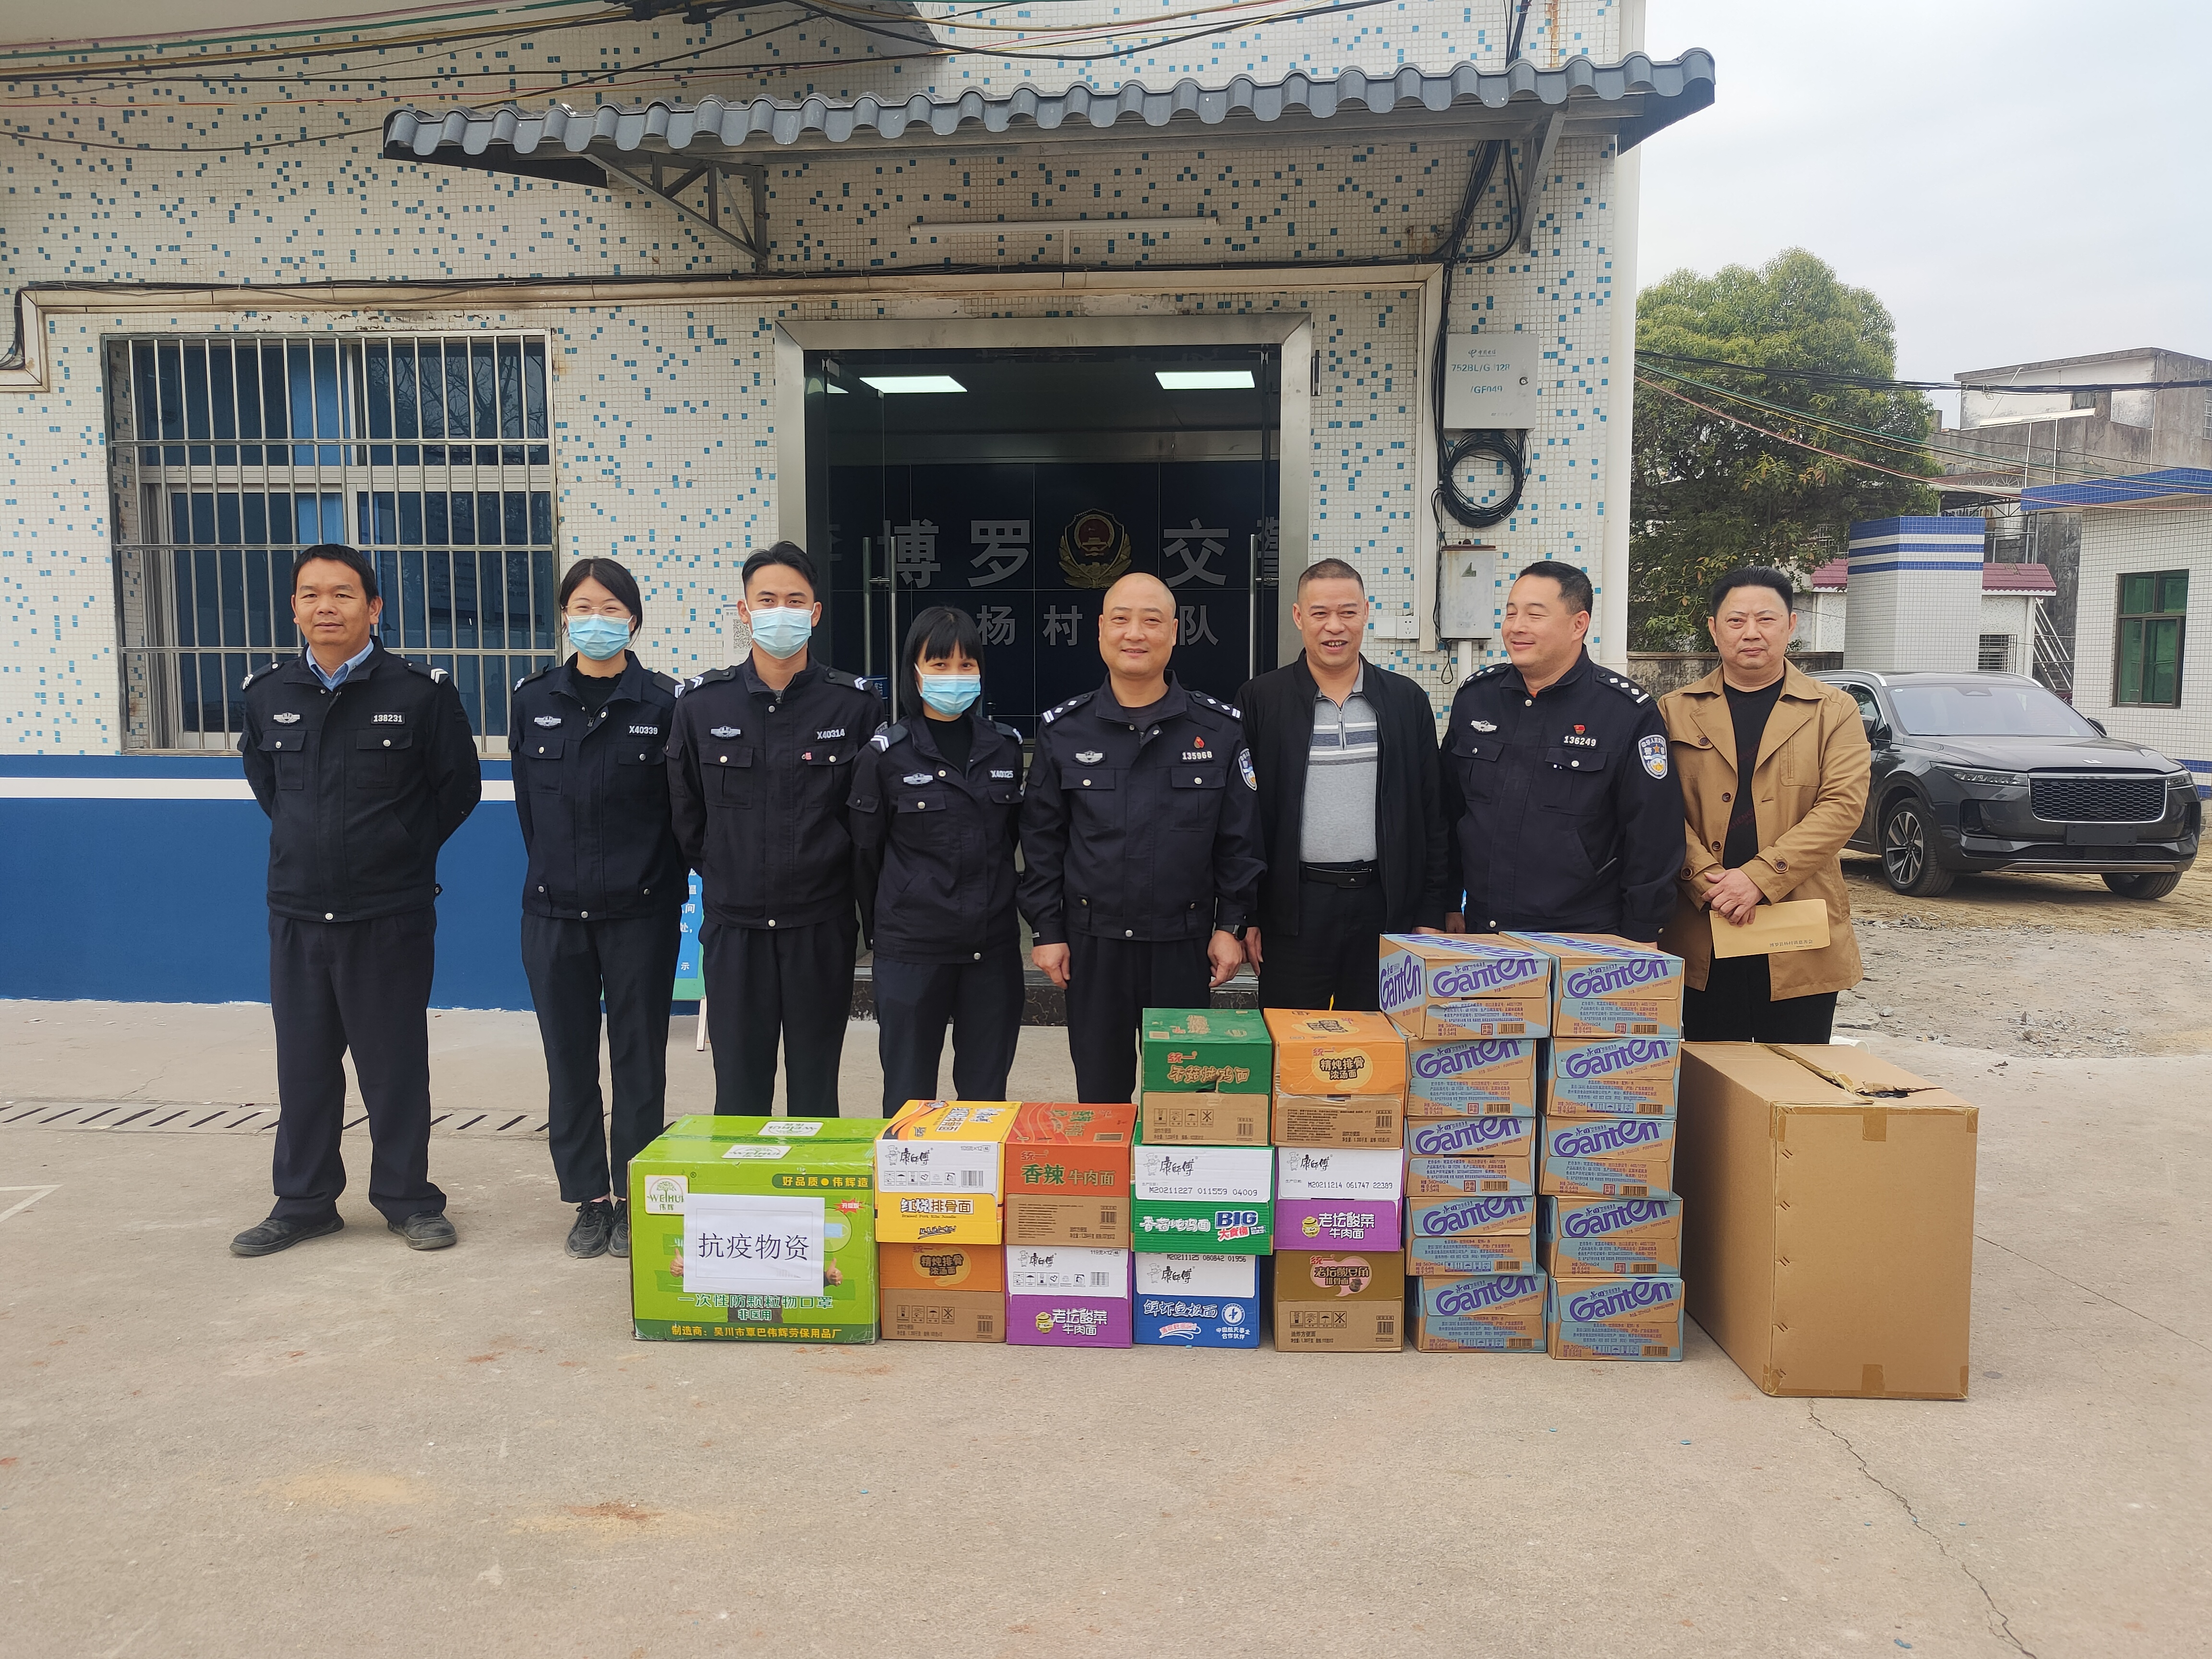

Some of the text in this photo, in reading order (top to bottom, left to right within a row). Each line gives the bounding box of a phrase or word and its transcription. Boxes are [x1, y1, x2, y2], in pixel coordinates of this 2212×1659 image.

[373, 714, 402, 723] 138231
[629, 725, 658, 734] X40339
[817, 728, 845, 739] X40314
[1563, 735, 1596, 746] 136249
[1433, 958, 1537, 997] Ganten
[1567, 959, 1669, 998] Ganten
[1167, 1052, 1196, 1063] 统一
[1312, 1048, 1334, 1056] 统一
[1416, 1039, 1520, 1078] Ganten
[1566, 1039, 1669, 1078] Ganten
[1320, 1056, 1365, 1071] 精炖排骨
[1167, 1065, 1250, 1084] 香菇炖鸡面
[1329, 1070, 1358, 1081] 浓汤面
[1416, 1117, 1521, 1154] Ganten
[1554, 1120, 1659, 1157] Ganten
[1021, 1151, 1047, 1161] 统一
[901, 1198, 974, 1214] 红烧排骨面
[1216, 1211, 1258, 1228] BIG
[1318, 1212, 1375, 1228] 老坛酸菜
[1423, 1197, 1525, 1235] Ganten
[1565, 1200, 1667, 1238] Ganten
[1217, 1226, 1250, 1242] 大食桶
[1329, 1228, 1364, 1239] 牛肉面
[697, 1233, 809, 1261] 抗疫物资
[920, 1254, 964, 1268] 精炖排骨
[1310, 1255, 1334, 1264] 统一
[929, 1266, 957, 1276] 浓汤面
[1314, 1266, 1370, 1278] 老坛酸豆角
[678, 1293, 833, 1309] 一次性防颗粒物口罩
[1436, 1276, 1537, 1316] Ganten
[1569, 1279, 1672, 1322] Ganten
[737, 1309, 772, 1321] 非医用
[1051, 1307, 1107, 1325] 老坛酸菜
[1062, 1324, 1097, 1336] 牛肉面
